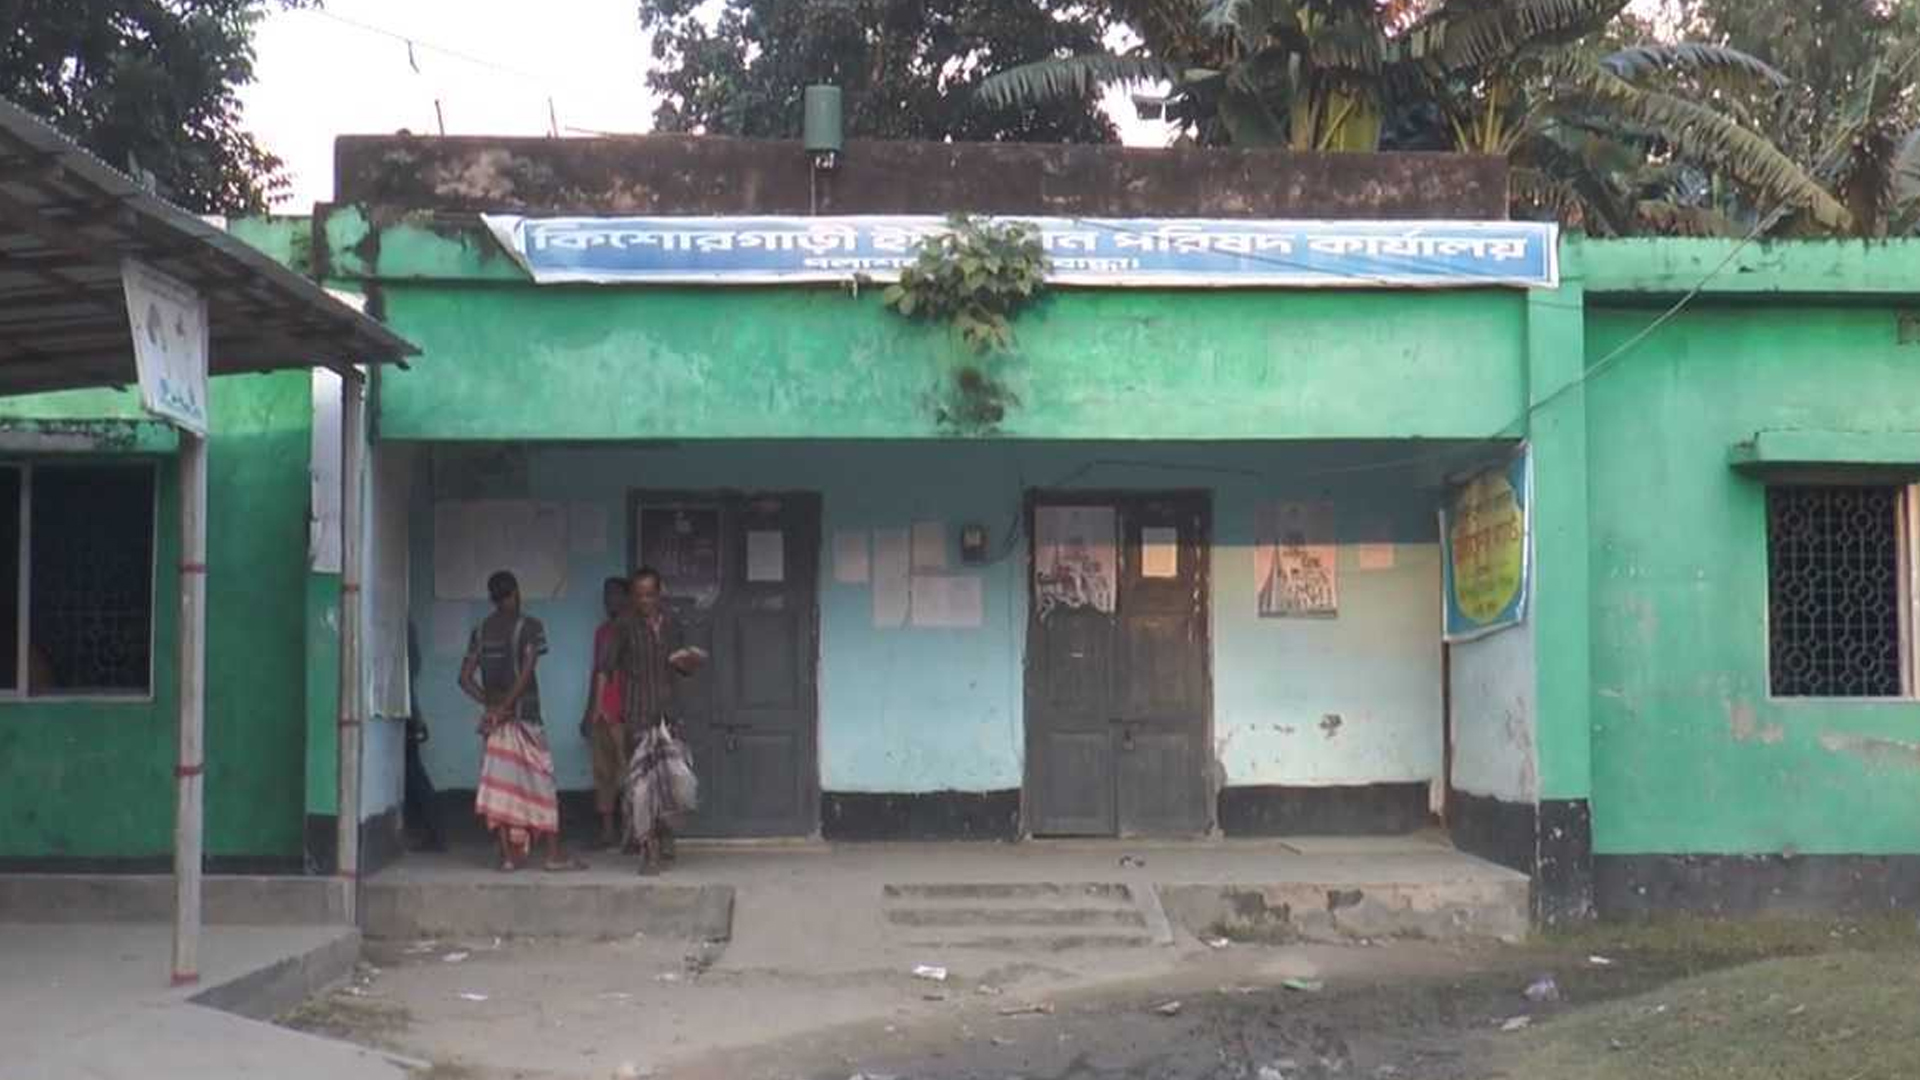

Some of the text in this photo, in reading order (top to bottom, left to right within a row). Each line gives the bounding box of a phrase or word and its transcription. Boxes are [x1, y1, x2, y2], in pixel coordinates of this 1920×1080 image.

[532, 224, 858, 254] কিশোরগাড়ী
[1114, 225, 1295, 254] পরিষদ
[1306, 229, 1528, 261] কার্যালয়
